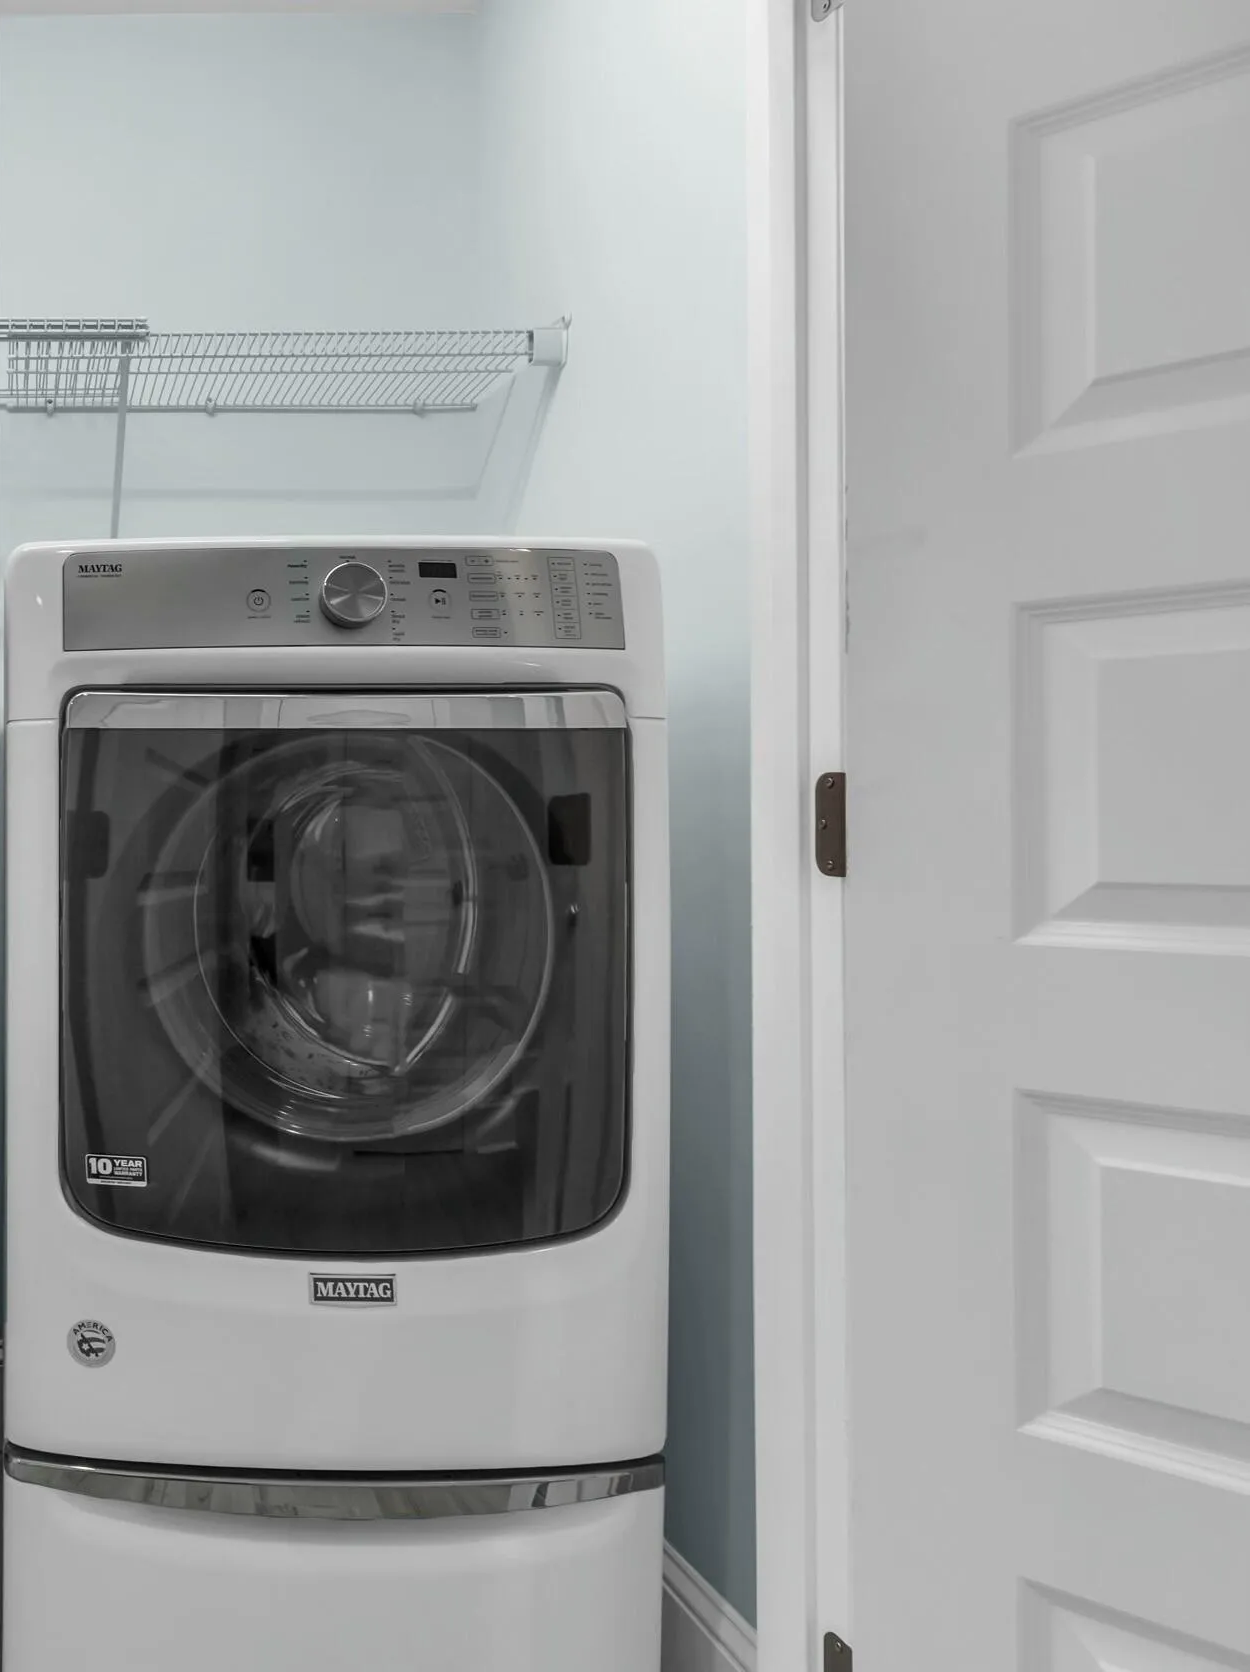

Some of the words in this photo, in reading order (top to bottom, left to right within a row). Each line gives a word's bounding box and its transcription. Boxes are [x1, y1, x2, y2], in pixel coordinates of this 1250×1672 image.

[78, 564, 122, 573] MAYTAG
[89, 1157, 113, 1175] 10
[113, 1159, 143, 1168] YEAR
[315, 1281, 392, 1298] MAYTAG
[72, 1321, 114, 1342] AMERICA
